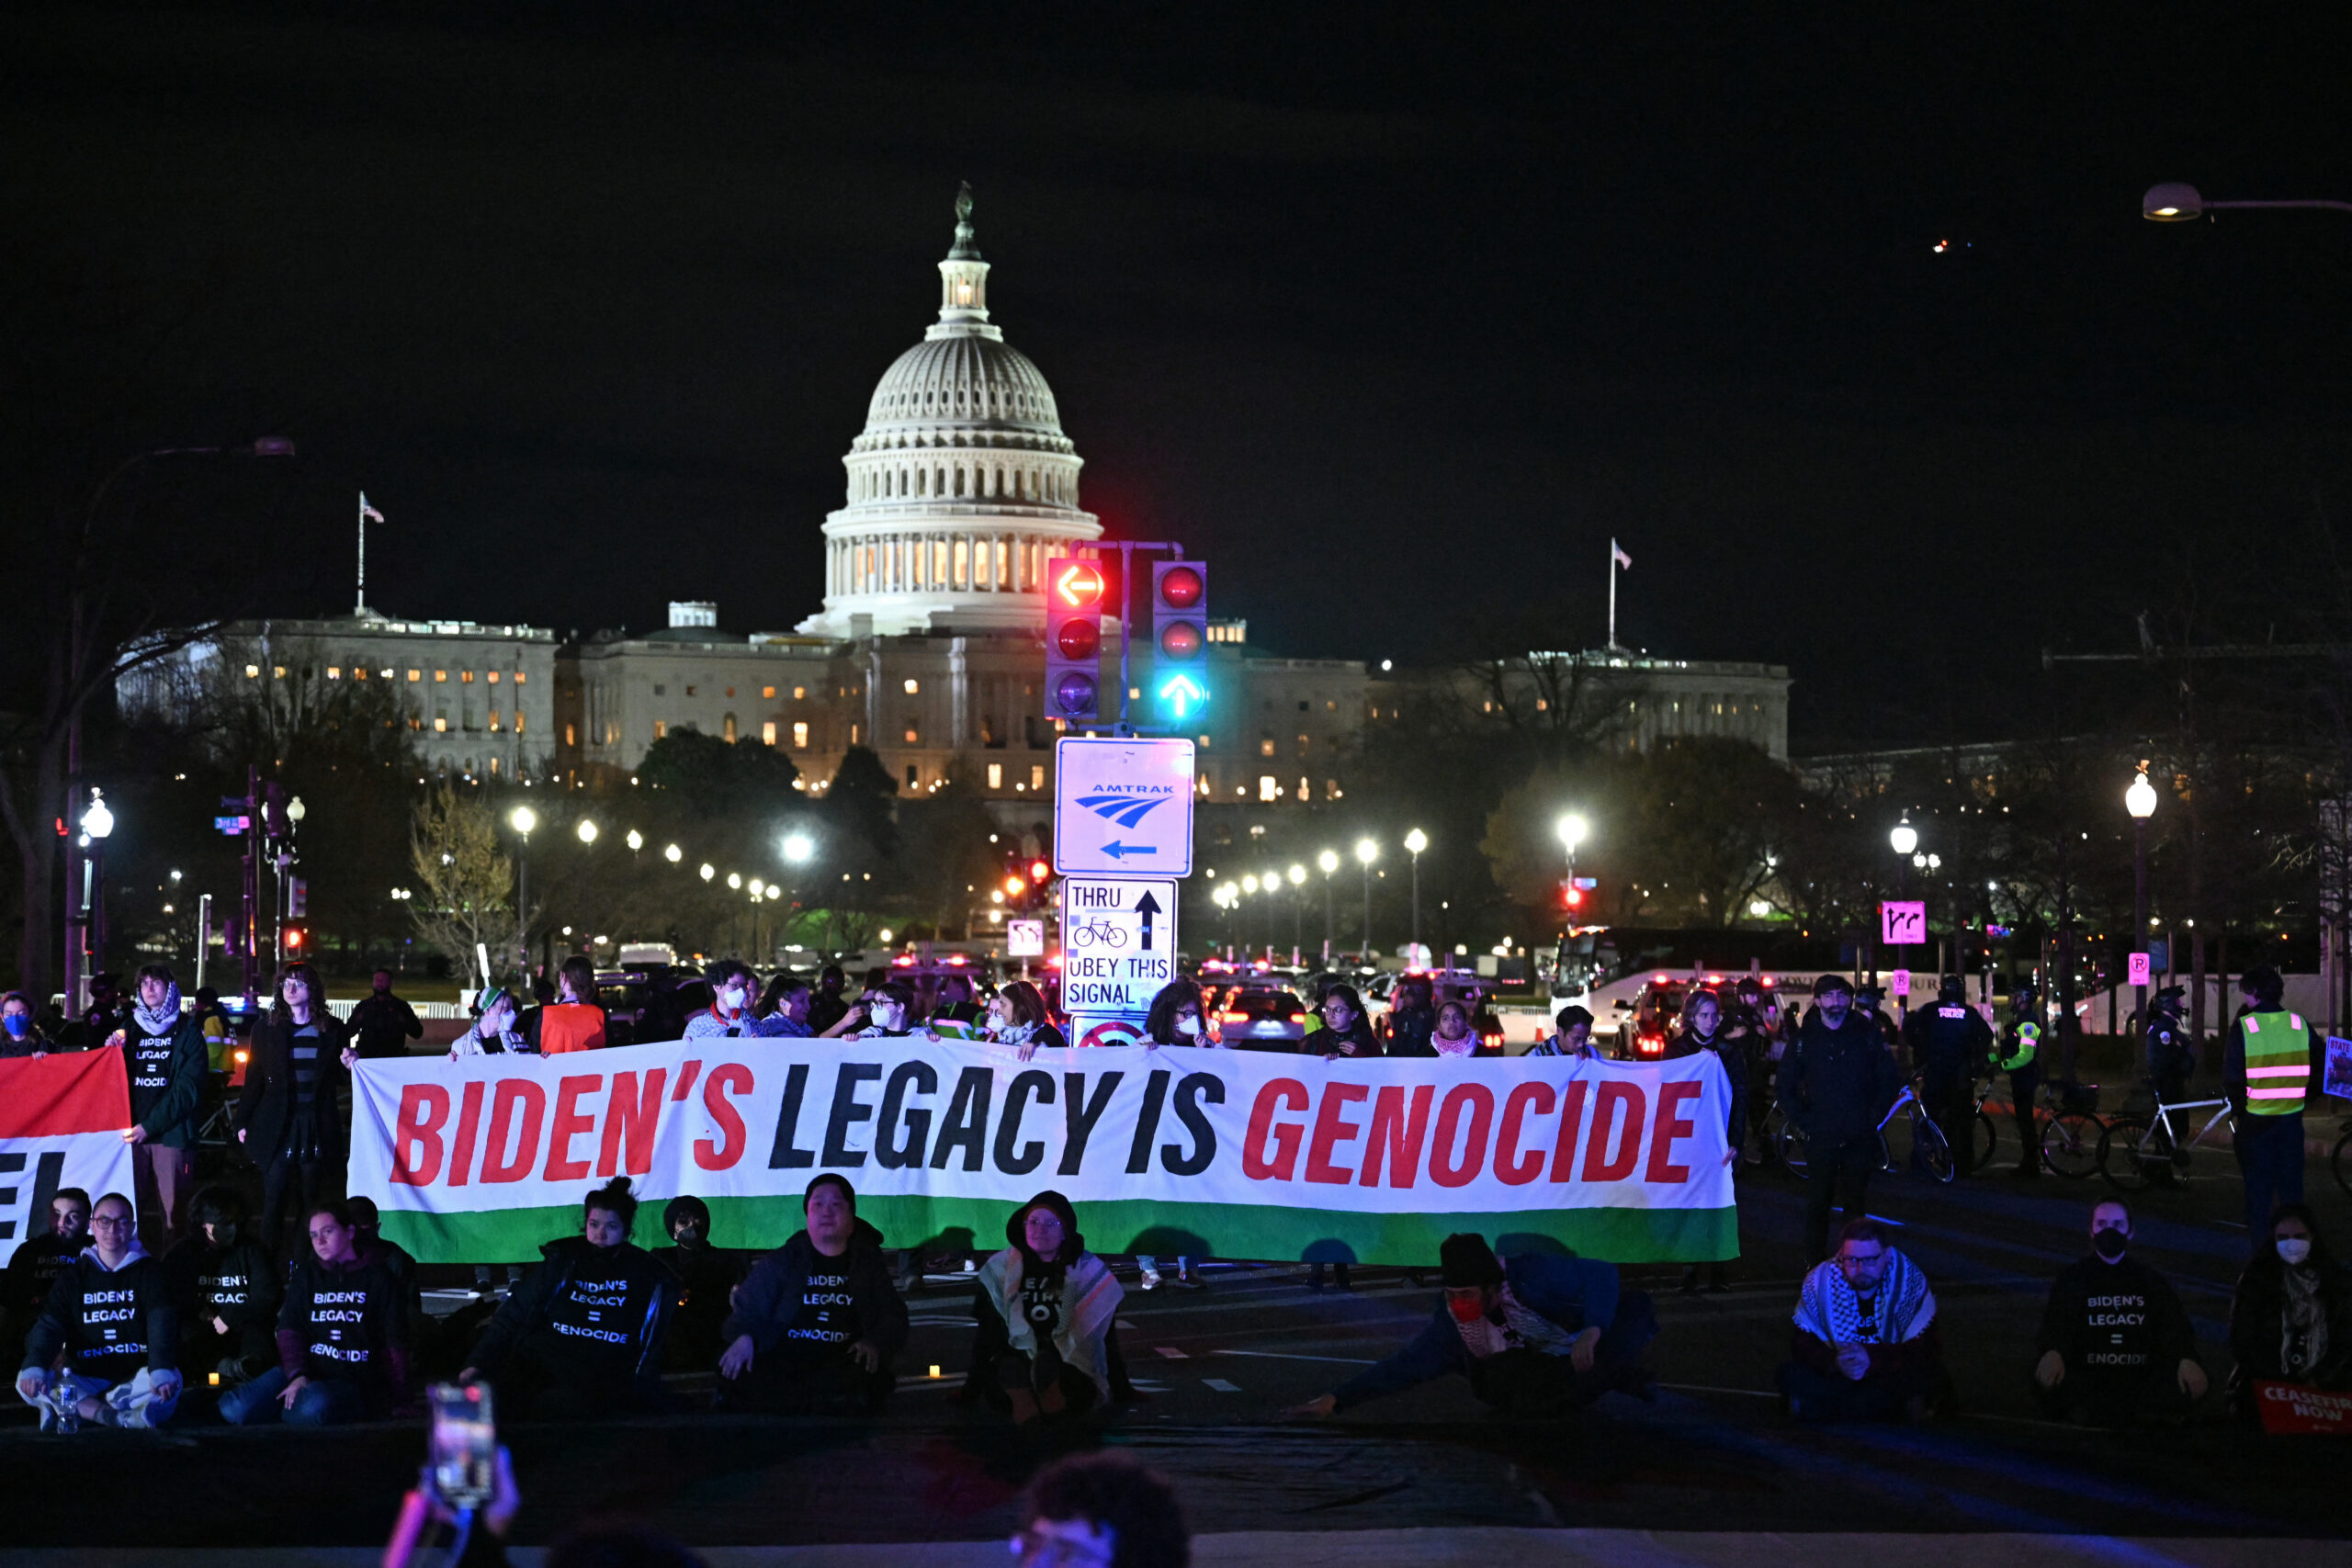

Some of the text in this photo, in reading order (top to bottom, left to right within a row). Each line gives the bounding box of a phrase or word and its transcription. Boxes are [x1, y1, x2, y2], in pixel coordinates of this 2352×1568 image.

[1093, 784, 1174, 794] AMTRAK
[1073, 886, 1121, 908] THRU
[1128, 958, 1168, 978] THIS
[1069, 983, 1136, 1004] SIGNAL
[390, 1060, 1702, 1189] BIDEN'S LEGACY IS GENOCIDE
[34, 1269, 59, 1279] LEG
[83, 1290, 134, 1304] BIDEN'S
[313, 1291, 368, 1303] BIDEN'S
[570, 1291, 627, 1307] LEGACY
[802, 1292, 854, 1305] LEGACY
[2086, 1294, 2145, 1308] BIDEN'S
[83, 1308, 135, 1324] LEGACY
[311, 1308, 364, 1323] LEGACY
[2088, 1314, 2145, 1326] LEGACY
[2264, 1387, 2352, 1410] CEASEFIR
[2293, 1403, 2343, 1421] NOW
